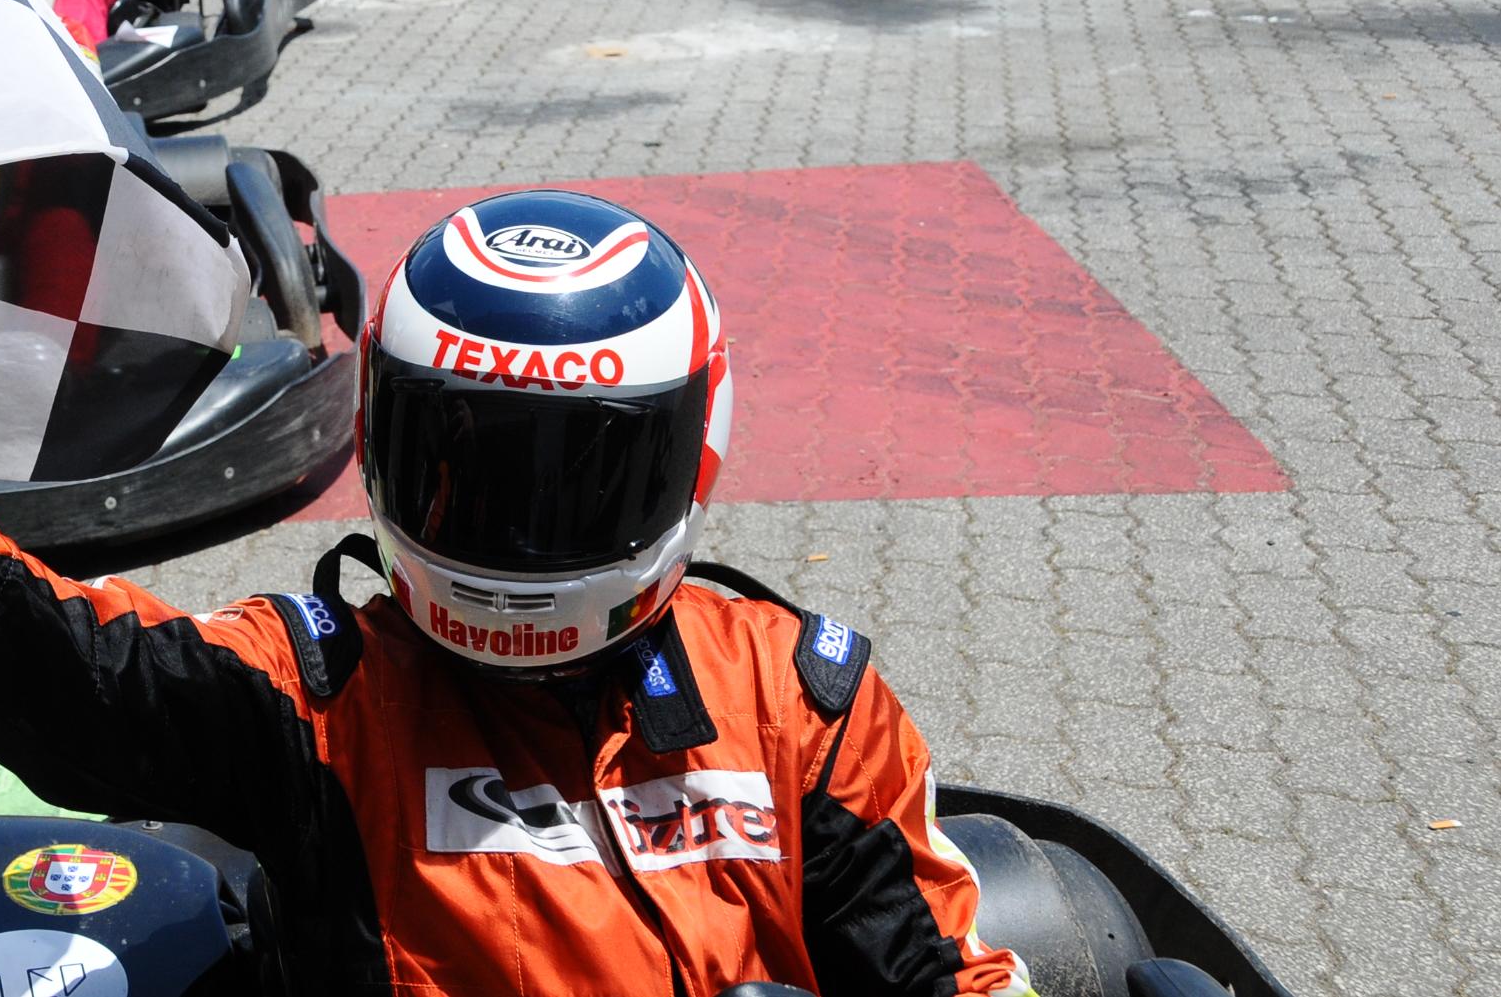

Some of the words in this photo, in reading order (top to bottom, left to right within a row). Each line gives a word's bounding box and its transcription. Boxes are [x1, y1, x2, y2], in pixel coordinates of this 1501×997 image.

[492, 229, 578, 253] Arai
[432, 329, 624, 391] TEXACO
[429, 601, 579, 656] Havoline
